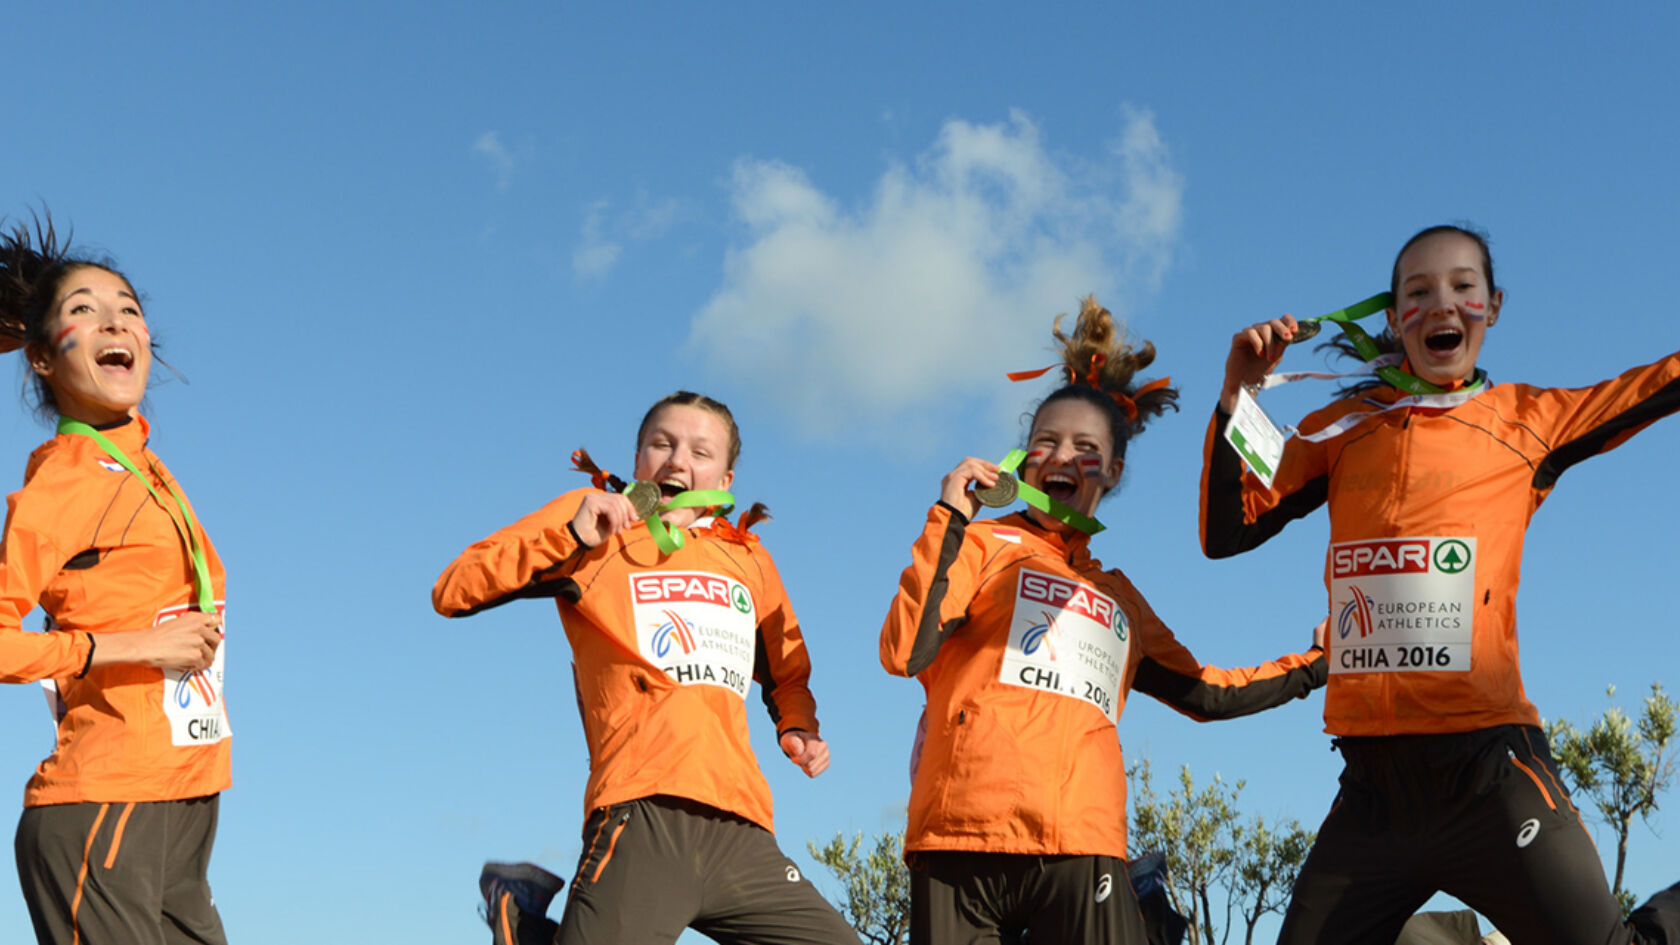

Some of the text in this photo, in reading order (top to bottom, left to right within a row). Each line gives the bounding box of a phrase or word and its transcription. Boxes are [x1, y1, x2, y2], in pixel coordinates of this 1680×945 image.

[1334, 544, 1427, 574] SPAR
[636, 577, 729, 604] SPAR
[1023, 576, 1111, 624] SPAR
[1377, 601, 1462, 615] EUROPEAN
[698, 625, 751, 649] EUROPEAN
[1377, 616, 1461, 630] ATHLETICS
[701, 639, 751, 663] ATHLETICS
[1077, 639, 1120, 674] UROPEAN
[1340, 646, 1451, 669] CHIA 2016
[663, 664, 746, 694] HIA 2016
[1077, 652, 1118, 688] THLETICS
[1019, 666, 1111, 715] CHI 2016
